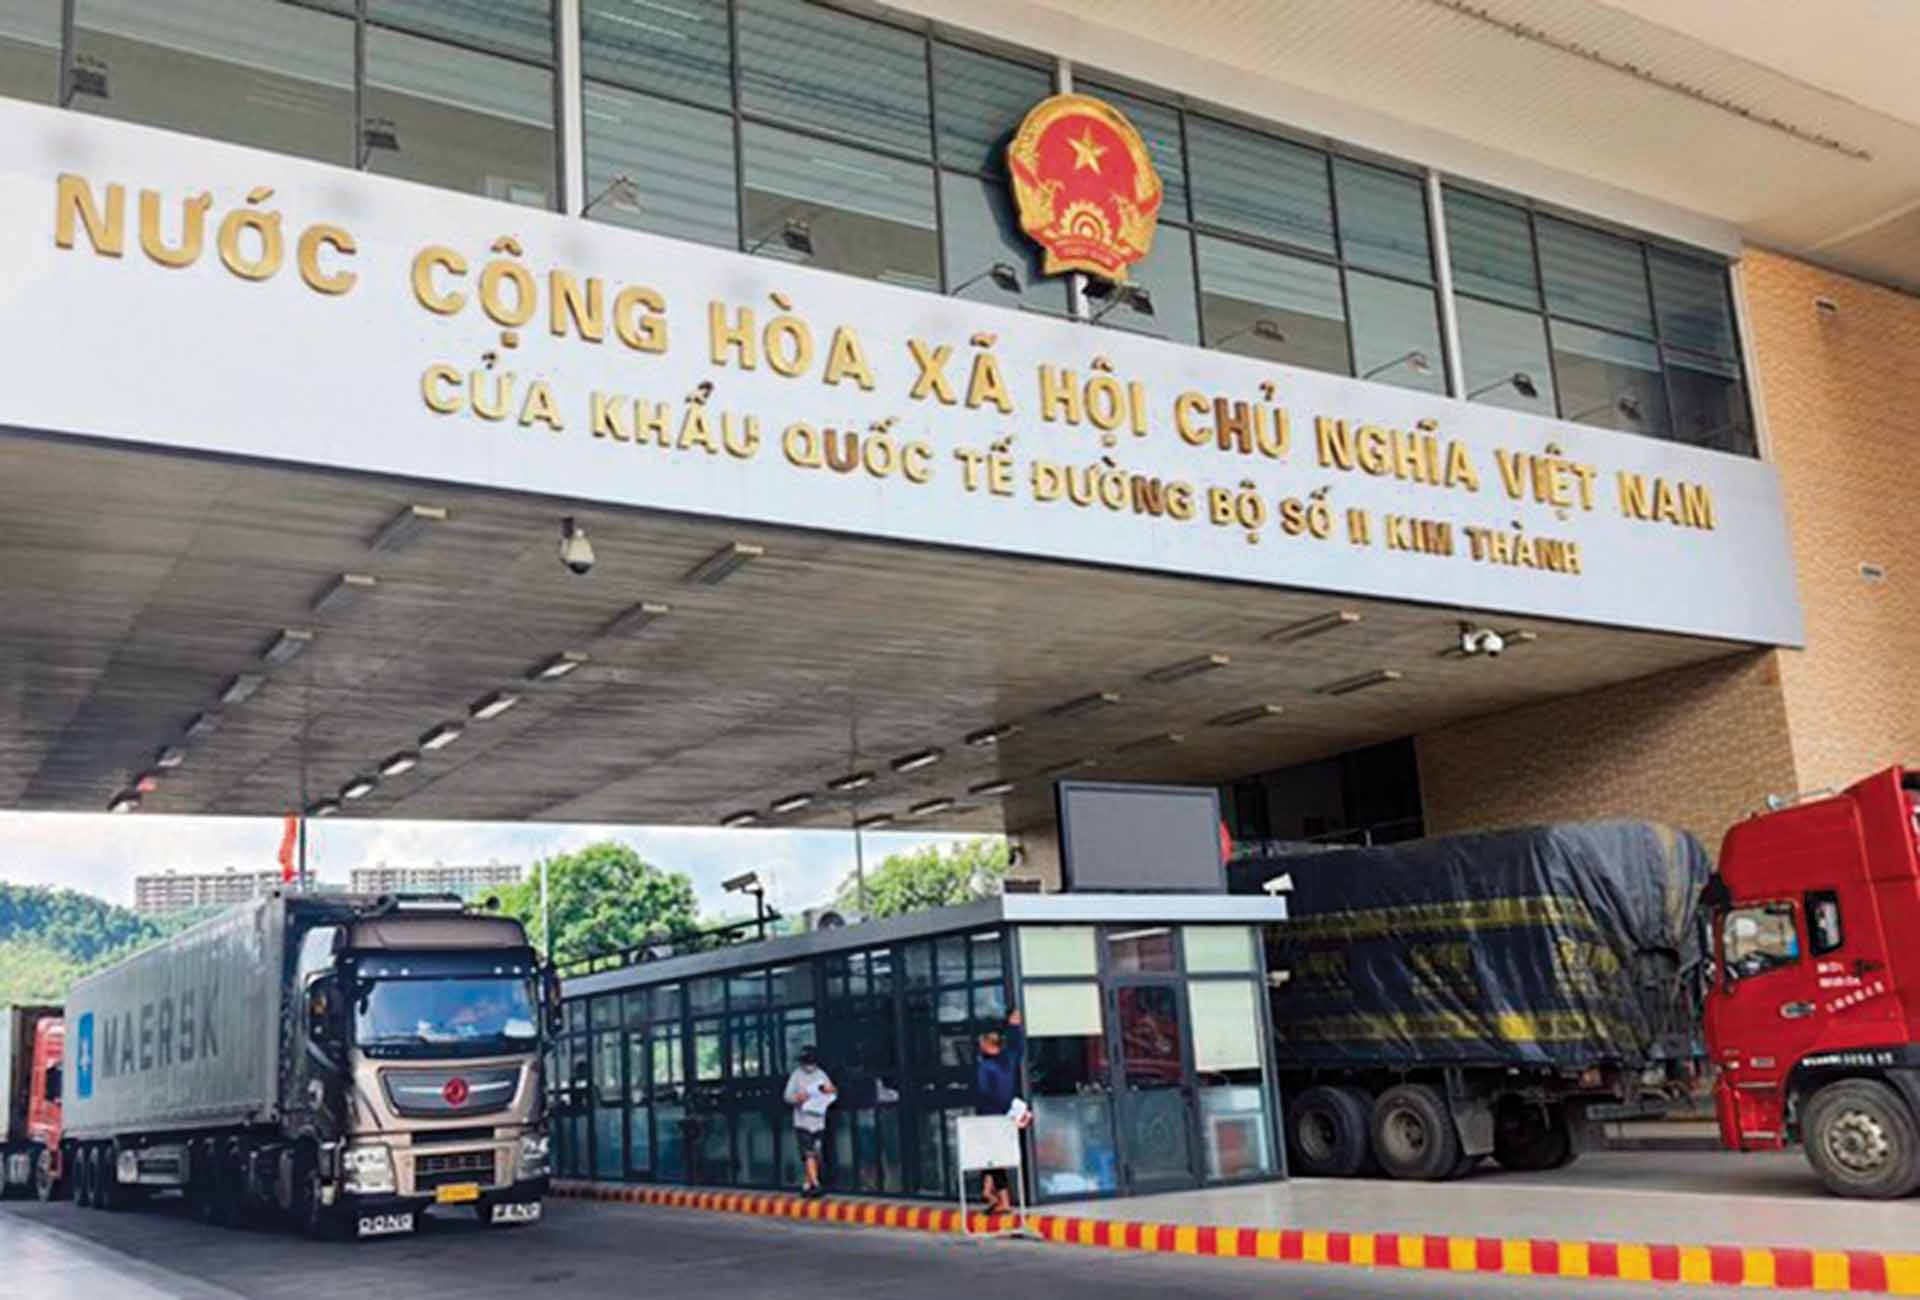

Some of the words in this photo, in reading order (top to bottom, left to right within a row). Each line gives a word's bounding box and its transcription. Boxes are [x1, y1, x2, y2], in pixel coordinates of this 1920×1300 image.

[54, 173, 358, 294] NƯỚC
[411, 236, 669, 354] CỘNG
[708, 291, 876, 392] HÒA
[908, 333, 1015, 414] XÃ
[1038, 354, 1147, 449] HỘI
[1173, 380, 1292, 460] CHỦ
[1314, 416, 1480, 493] NGHĨA
[1493, 442, 1598, 521] VIỆT
[1617, 469, 1718, 532] NAM
[421, 350, 563, 432] CỬA
[591, 380, 762, 460] KHẨU
[781, 414, 936, 485] QUỐC
[954, 434, 1017, 498] TẾ
[1030, 456, 1197, 523] ĐƯỜNG
[1207, 479, 1268, 545] BỘ
[1280, 484, 1338, 540] SỐ
[1384, 512, 1454, 557] KIM
[1463, 521, 1584, 576] THÀNH
[102, 979, 220, 1078] MAERSK
